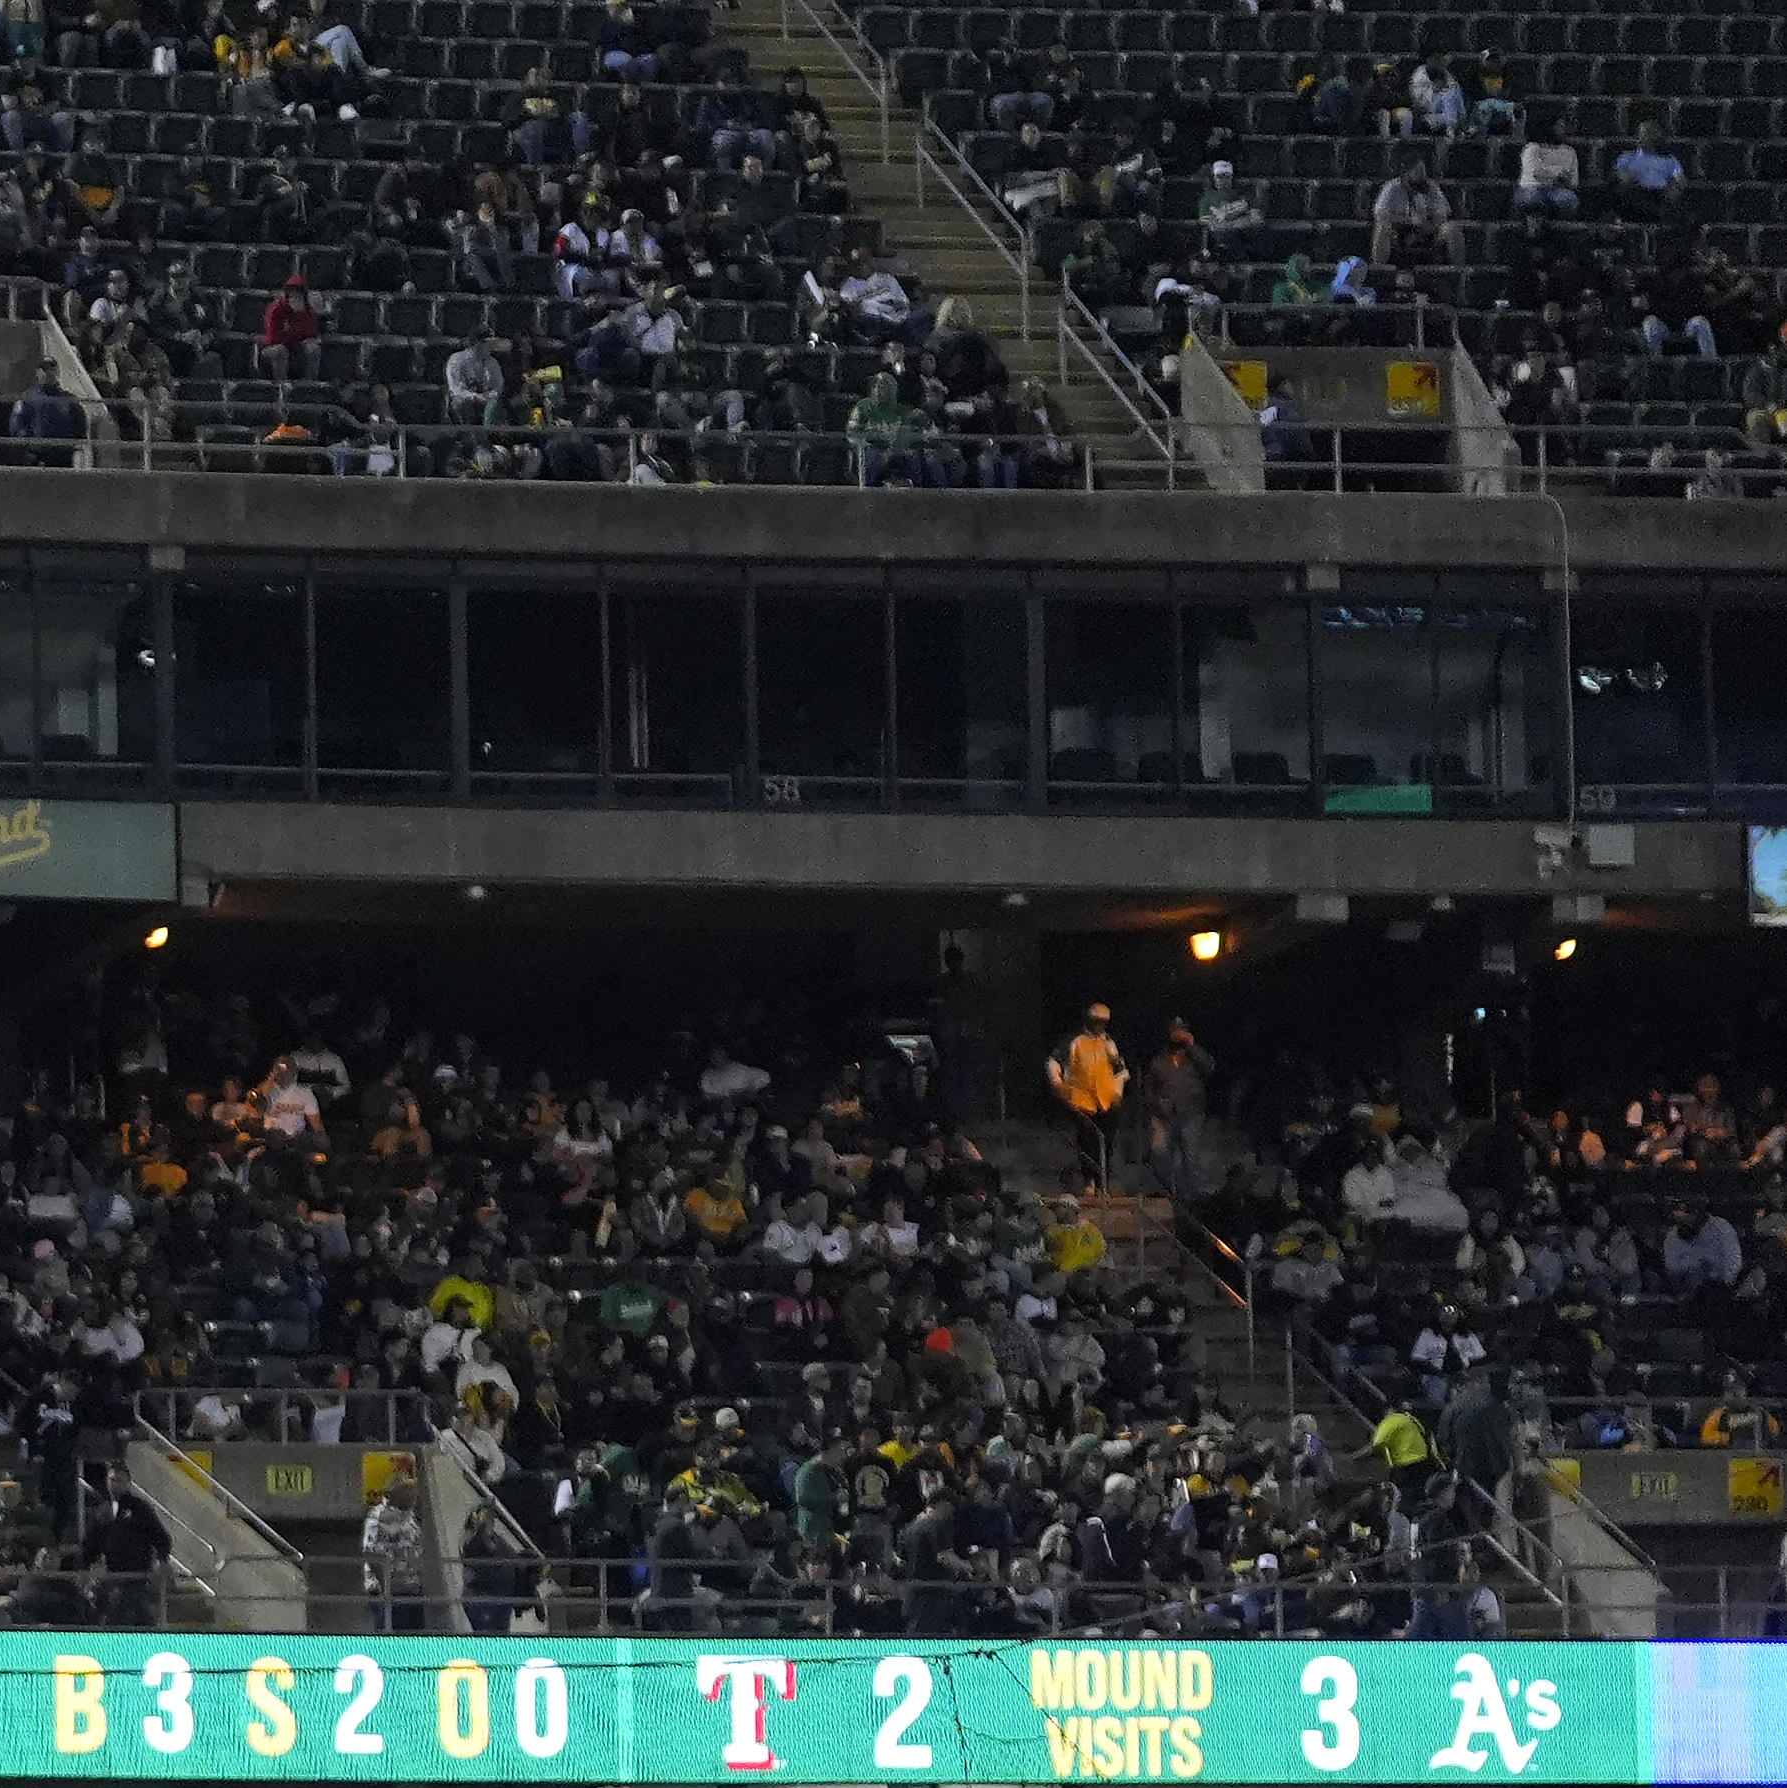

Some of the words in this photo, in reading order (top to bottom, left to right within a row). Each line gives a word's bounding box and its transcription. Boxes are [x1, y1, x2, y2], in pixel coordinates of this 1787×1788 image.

[272, 1468, 306, 1491] EXIT
[52, 1653, 108, 1755] B
[141, 1651, 195, 1755] 3
[245, 1655, 299, 1757] S
[333, 1653, 385, 1756] 2
[515, 1656, 569, 1760] 0
[697, 1653, 797, 1770] T
[872, 1654, 934, 1770] 2
[1029, 1647, 1215, 1713] MOUND
[1300, 1653, 1361, 1772] 3
[1428, 1652, 1563, 1775] A's
[1047, 1713, 1204, 1780] VISITS
